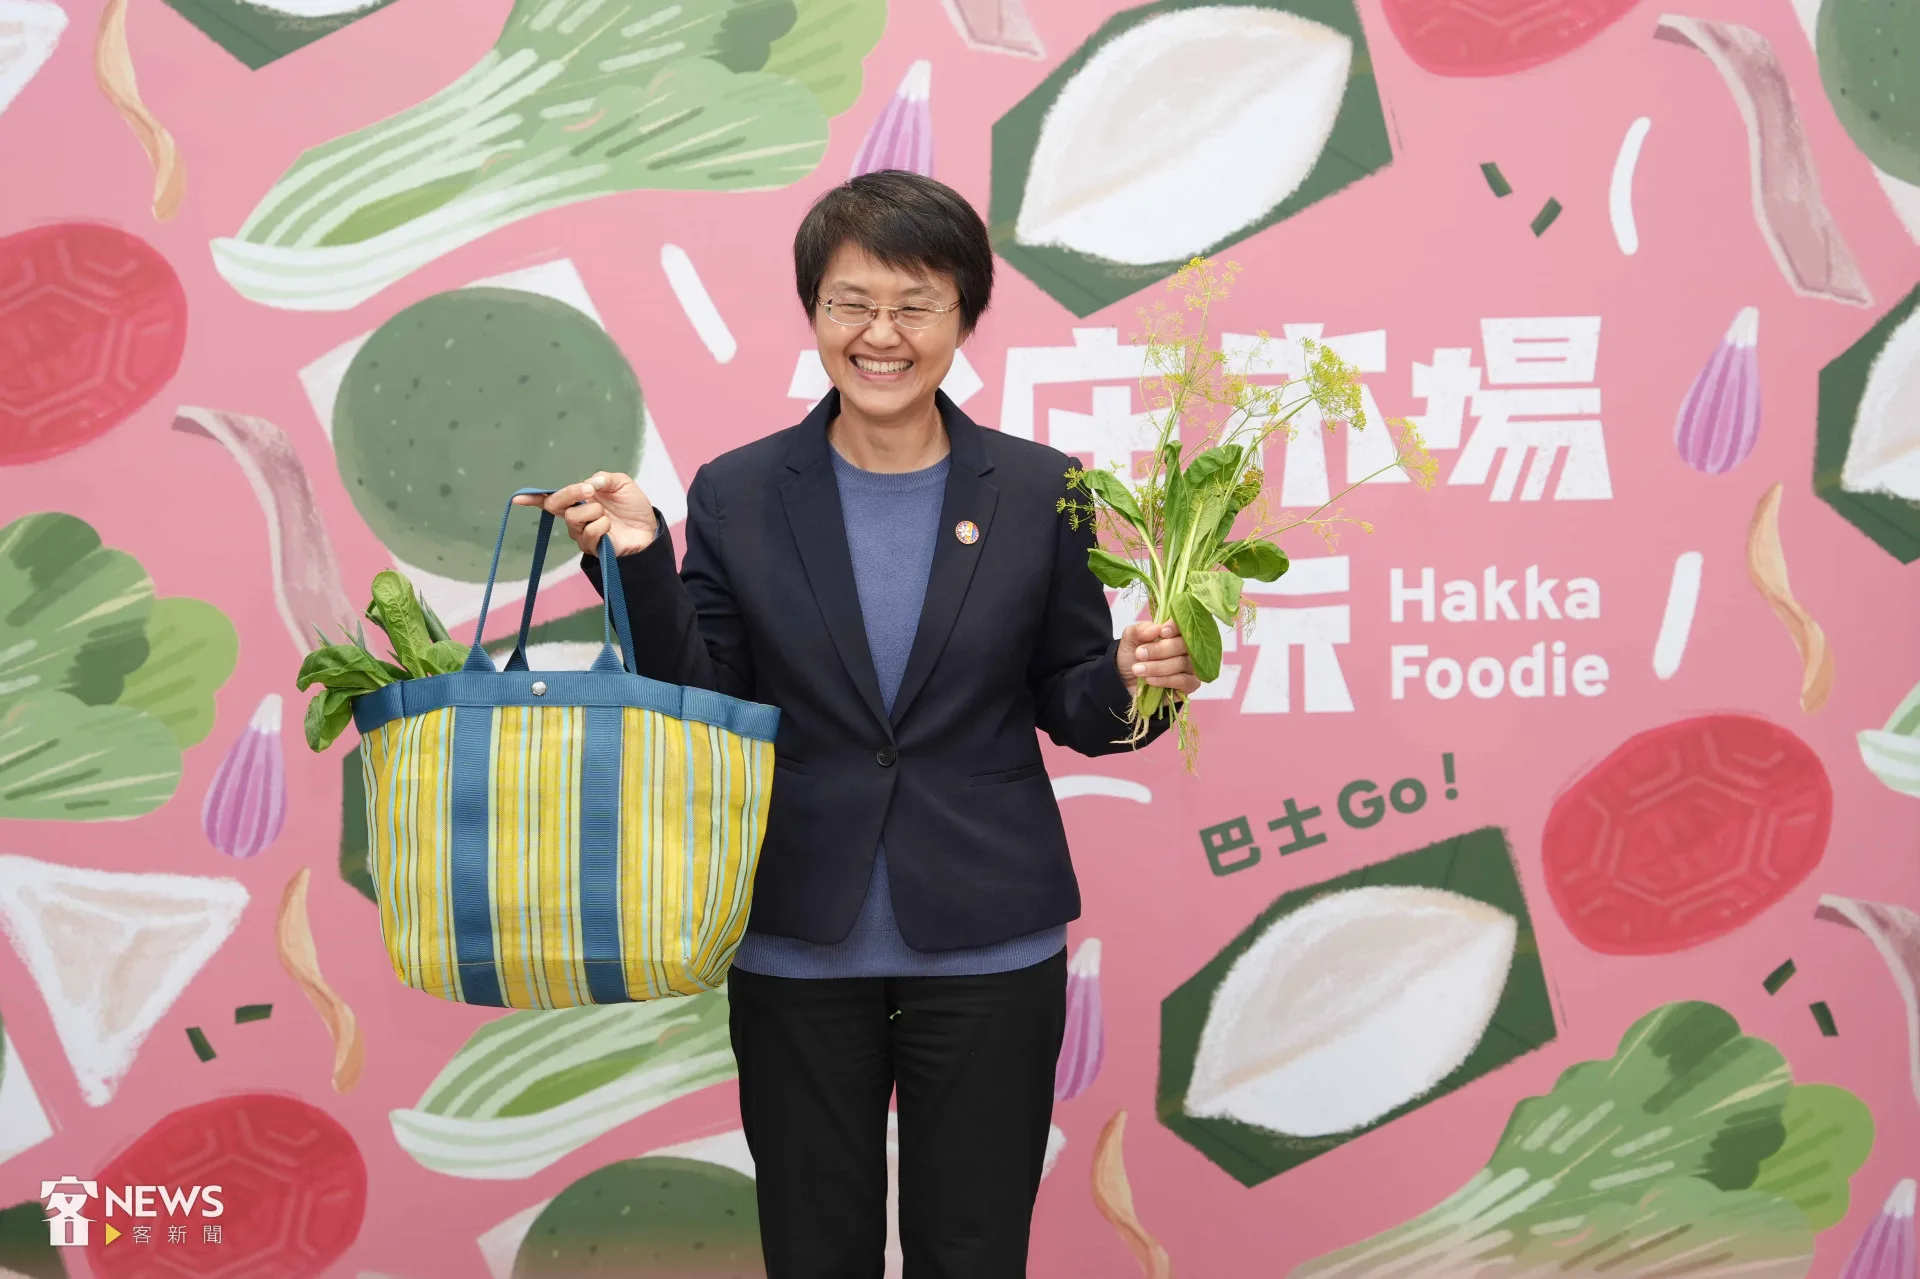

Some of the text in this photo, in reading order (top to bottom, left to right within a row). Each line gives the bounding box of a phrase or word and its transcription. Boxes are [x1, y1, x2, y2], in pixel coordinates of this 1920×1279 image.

[788, 316, 1613, 507] 庄市場
[1390, 564, 1601, 622] Hakka
[1391, 640, 1610, 700] Foodie
